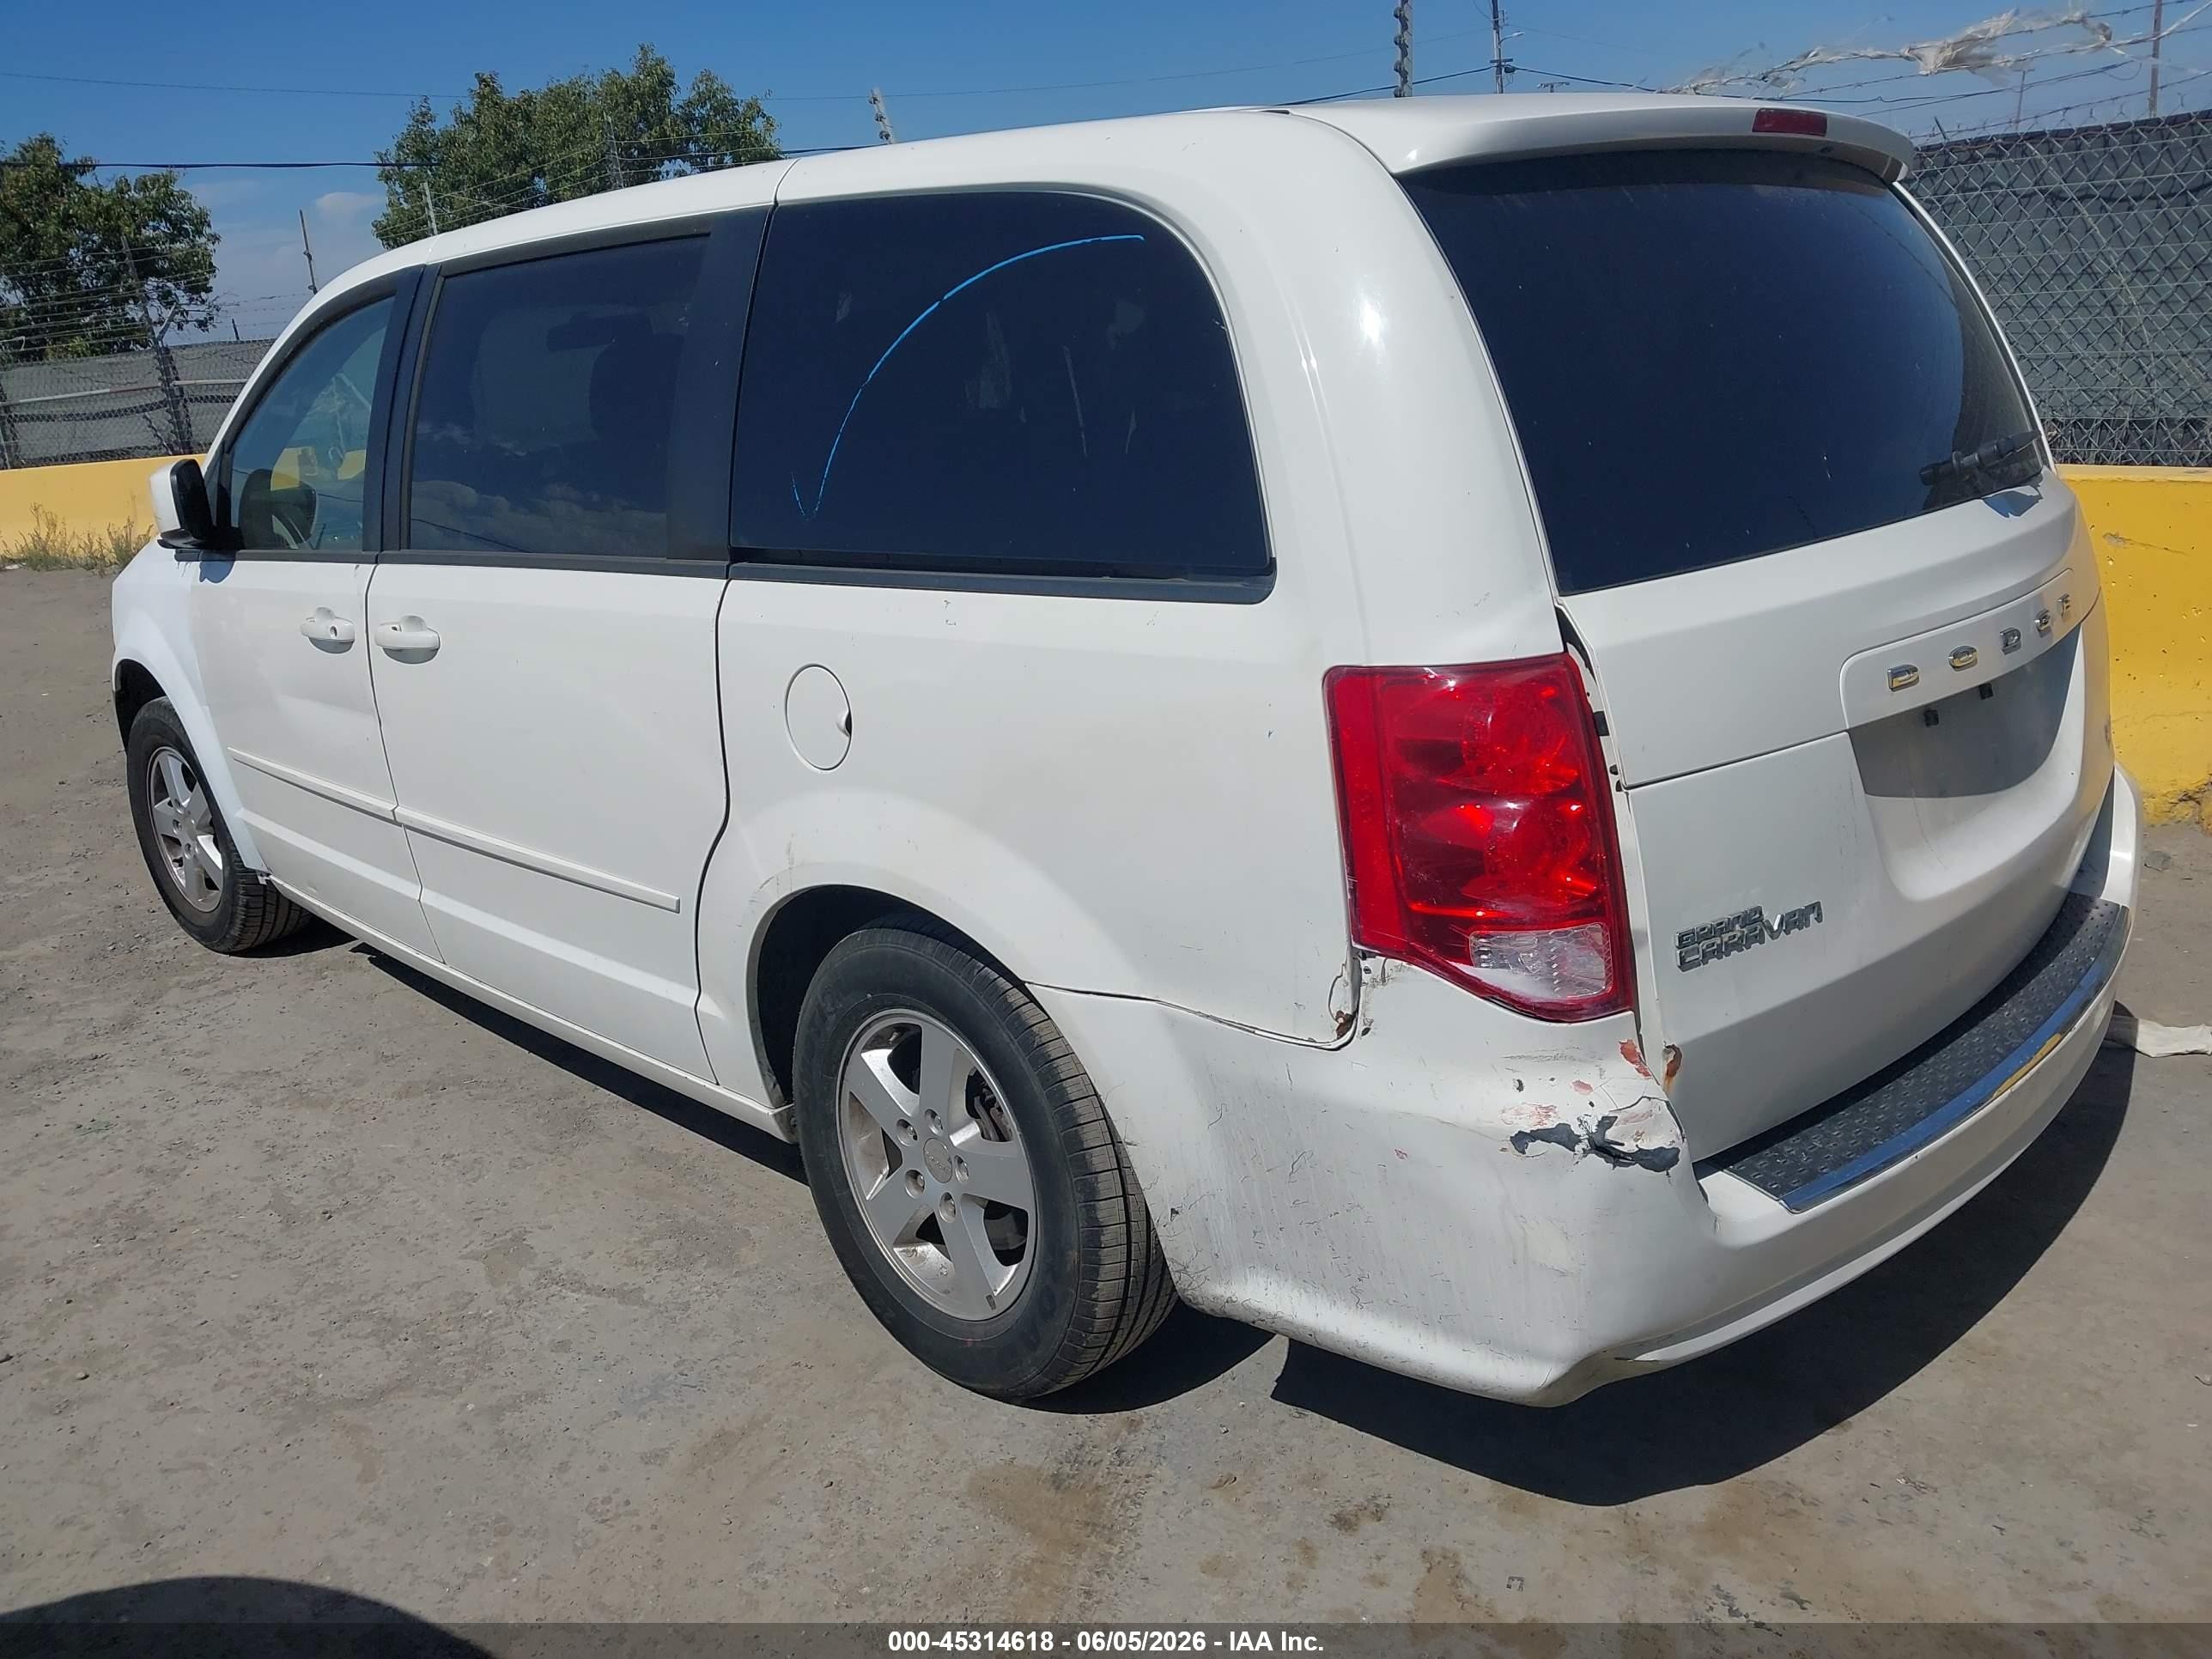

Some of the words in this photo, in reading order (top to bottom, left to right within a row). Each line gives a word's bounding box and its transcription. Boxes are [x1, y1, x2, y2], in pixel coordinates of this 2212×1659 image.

[1887, 592, 2071, 692] DODGE
[1675, 905, 1765, 949] GRAND
[1675, 901, 1824, 972] CARAVAN
